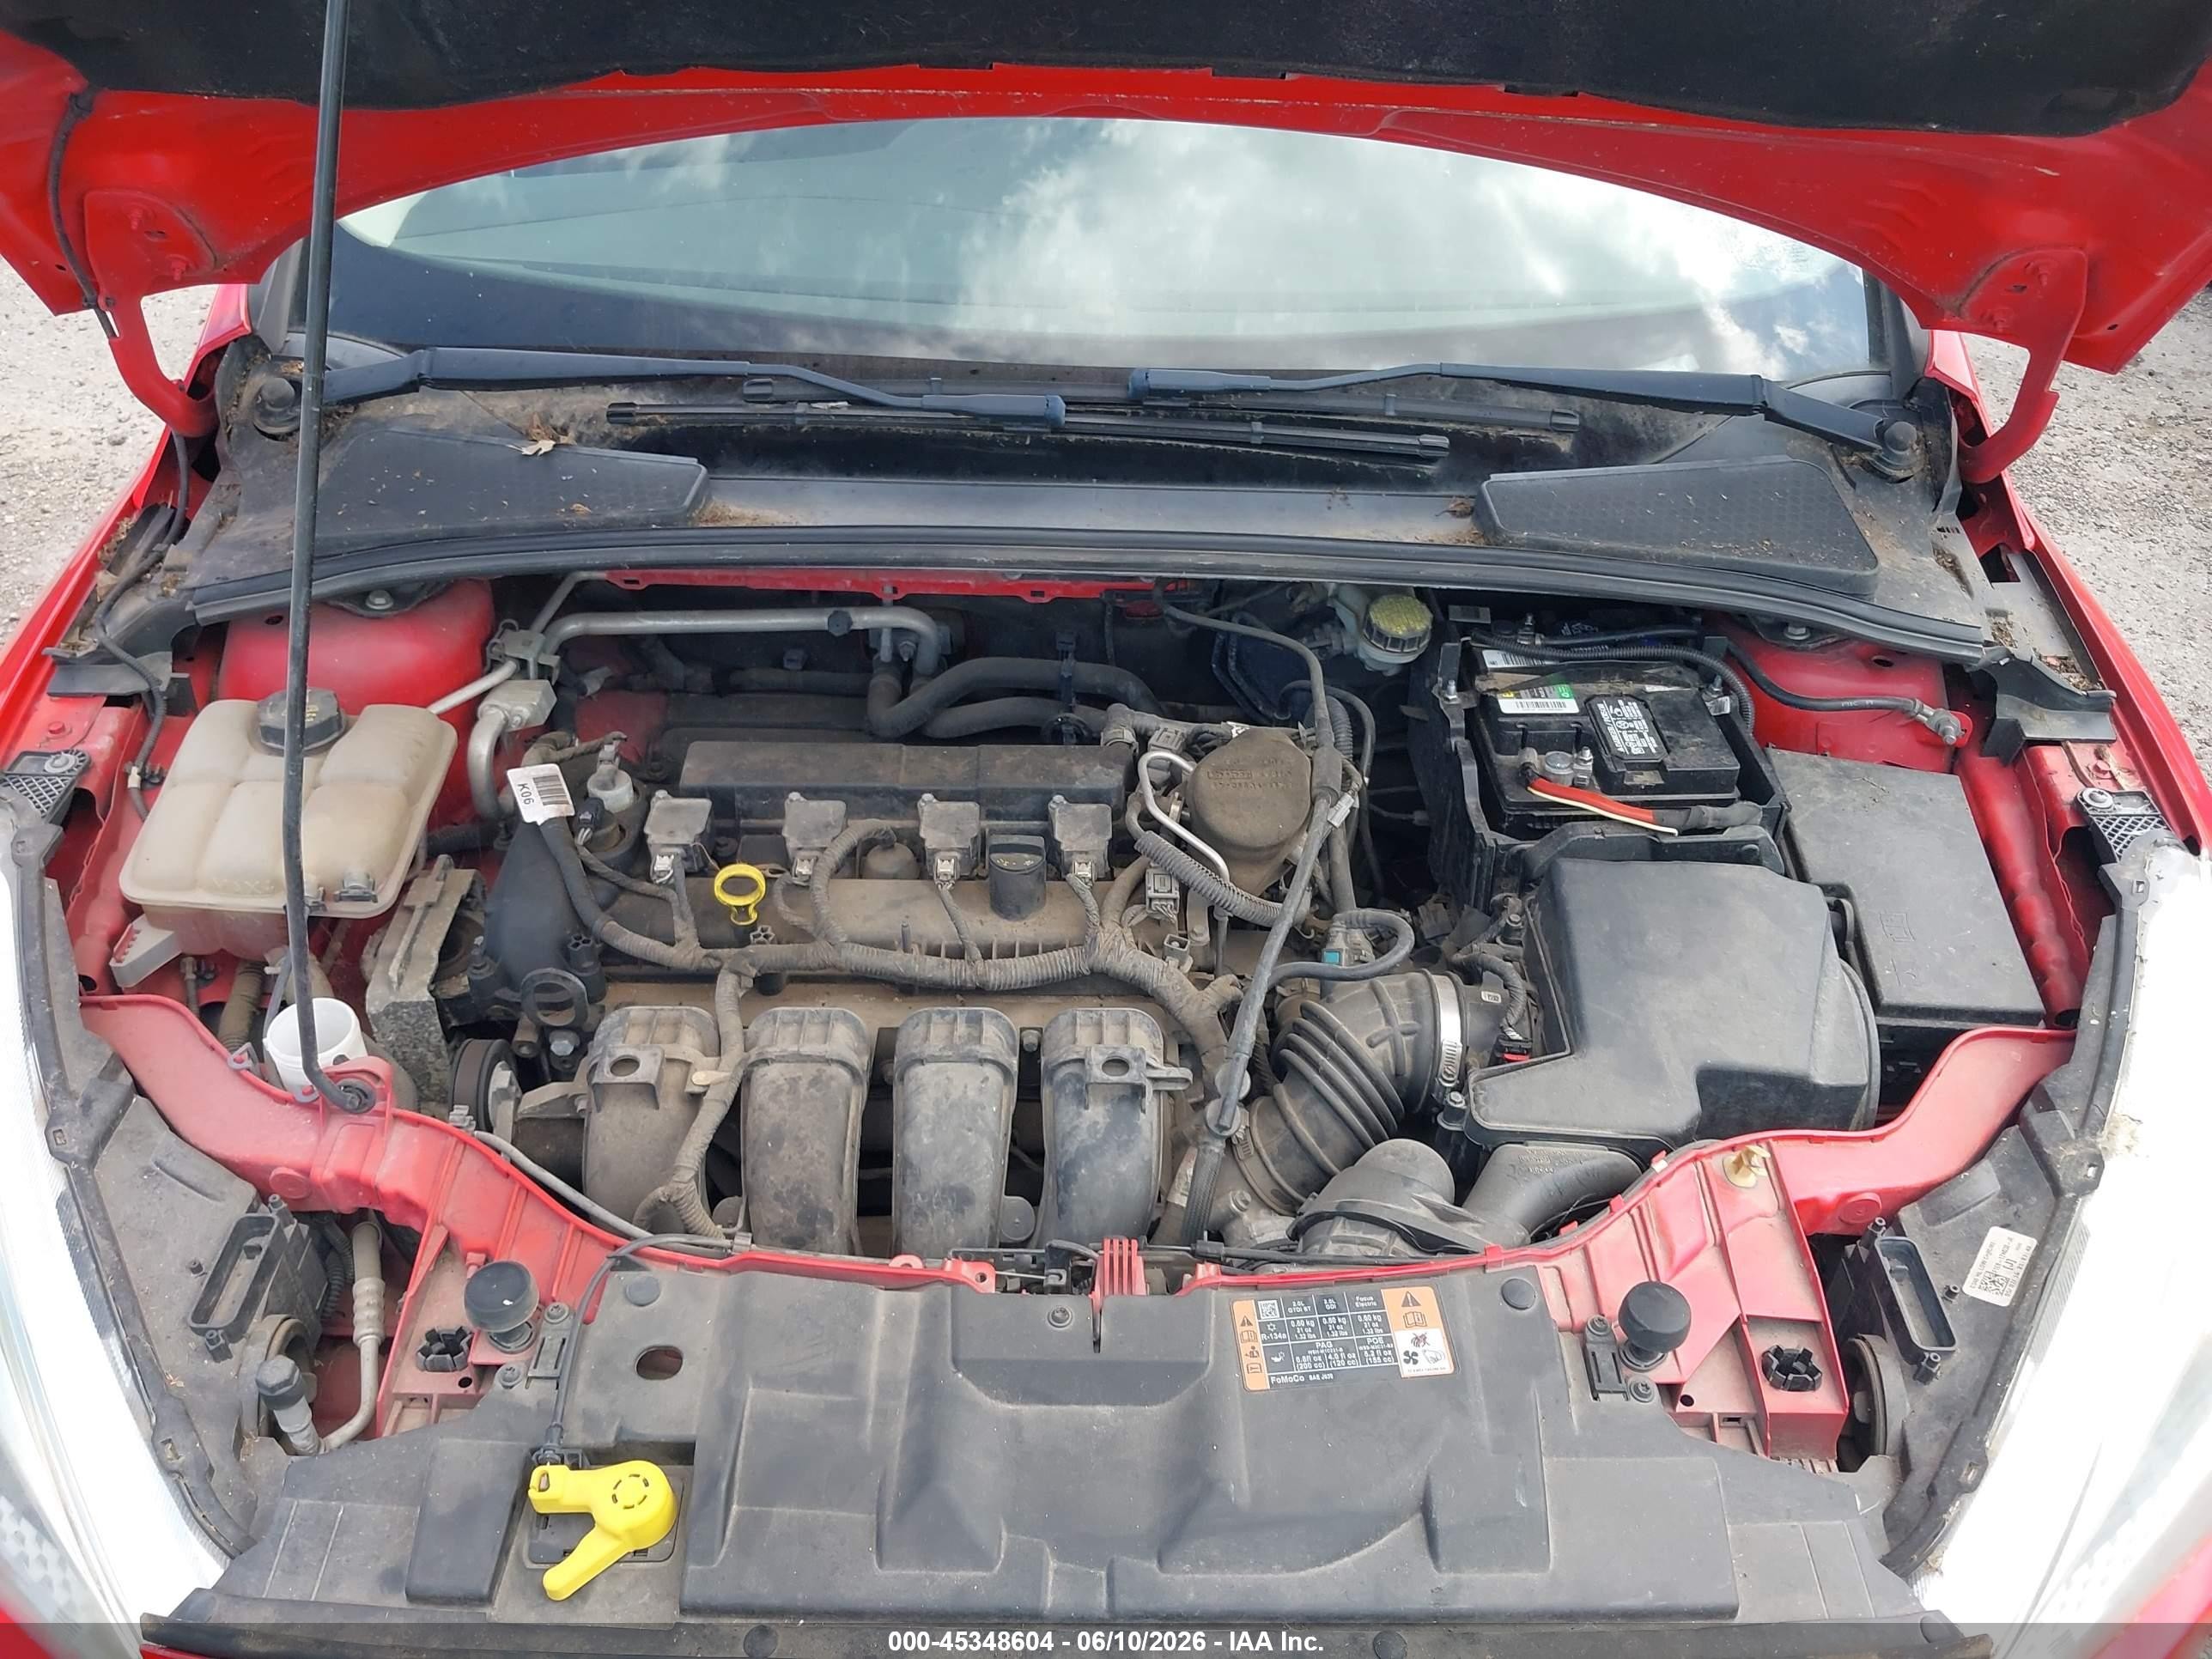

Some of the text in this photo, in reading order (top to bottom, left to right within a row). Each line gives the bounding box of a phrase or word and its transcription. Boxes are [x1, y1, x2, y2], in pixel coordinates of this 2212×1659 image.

[517, 782, 534, 805] K06
[1338, 1316, 1346, 1325] kg
[1373, 1314, 1382, 1322] kg
[1305, 1319, 1315, 1328] kg
[1382, 1355, 1395, 1364] cc)
[1297, 1362, 1312, 1371] (200
[1270, 1375, 1305, 1384] FoMoCo
